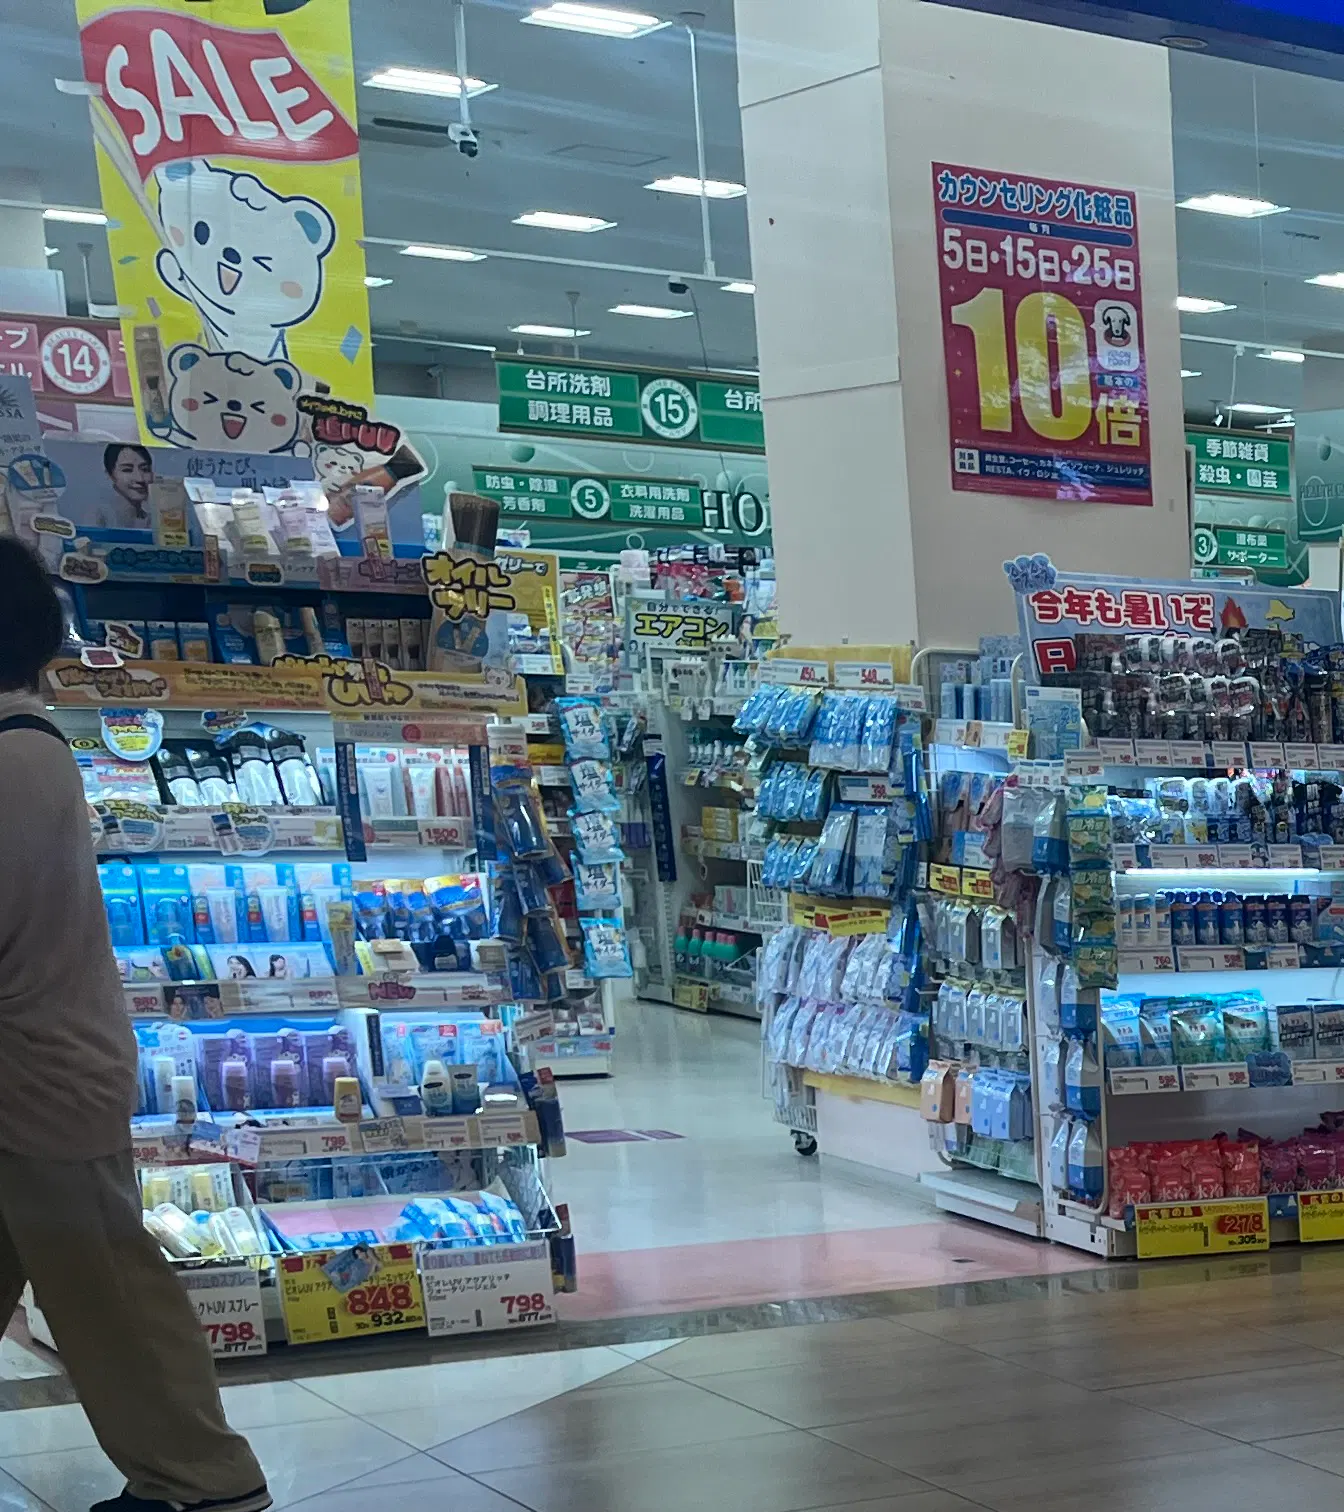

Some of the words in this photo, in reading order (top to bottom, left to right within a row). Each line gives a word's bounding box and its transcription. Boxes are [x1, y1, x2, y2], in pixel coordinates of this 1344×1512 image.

[103, 28, 335, 157] SALE
[938, 169, 1135, 229] カウンセリング化粧品
[57, 344, 95, 378] 14
[950, 286, 1093, 442] 10
[525, 369, 611, 397] 台所洗剤
[528, 400, 614, 428] 調理用品
[654, 392, 685, 424] 15
[1095, 391, 1143, 447] 倍
[1205, 438, 1269, 463] 季節雑貨
[584, 488, 597, 509] 5
[1197, 535, 1209, 555] 3
[1226, 549, 1279, 564] サポーター
[1030, 587, 1214, 632] 今年も暑いぞ
[633, 612, 730, 640] エアコン
[346, 1283, 412, 1315] 848
[499, 1293, 545, 1314] 798
[204, 1321, 255, 1343] 798
[371, 1311, 404, 1327] 932
